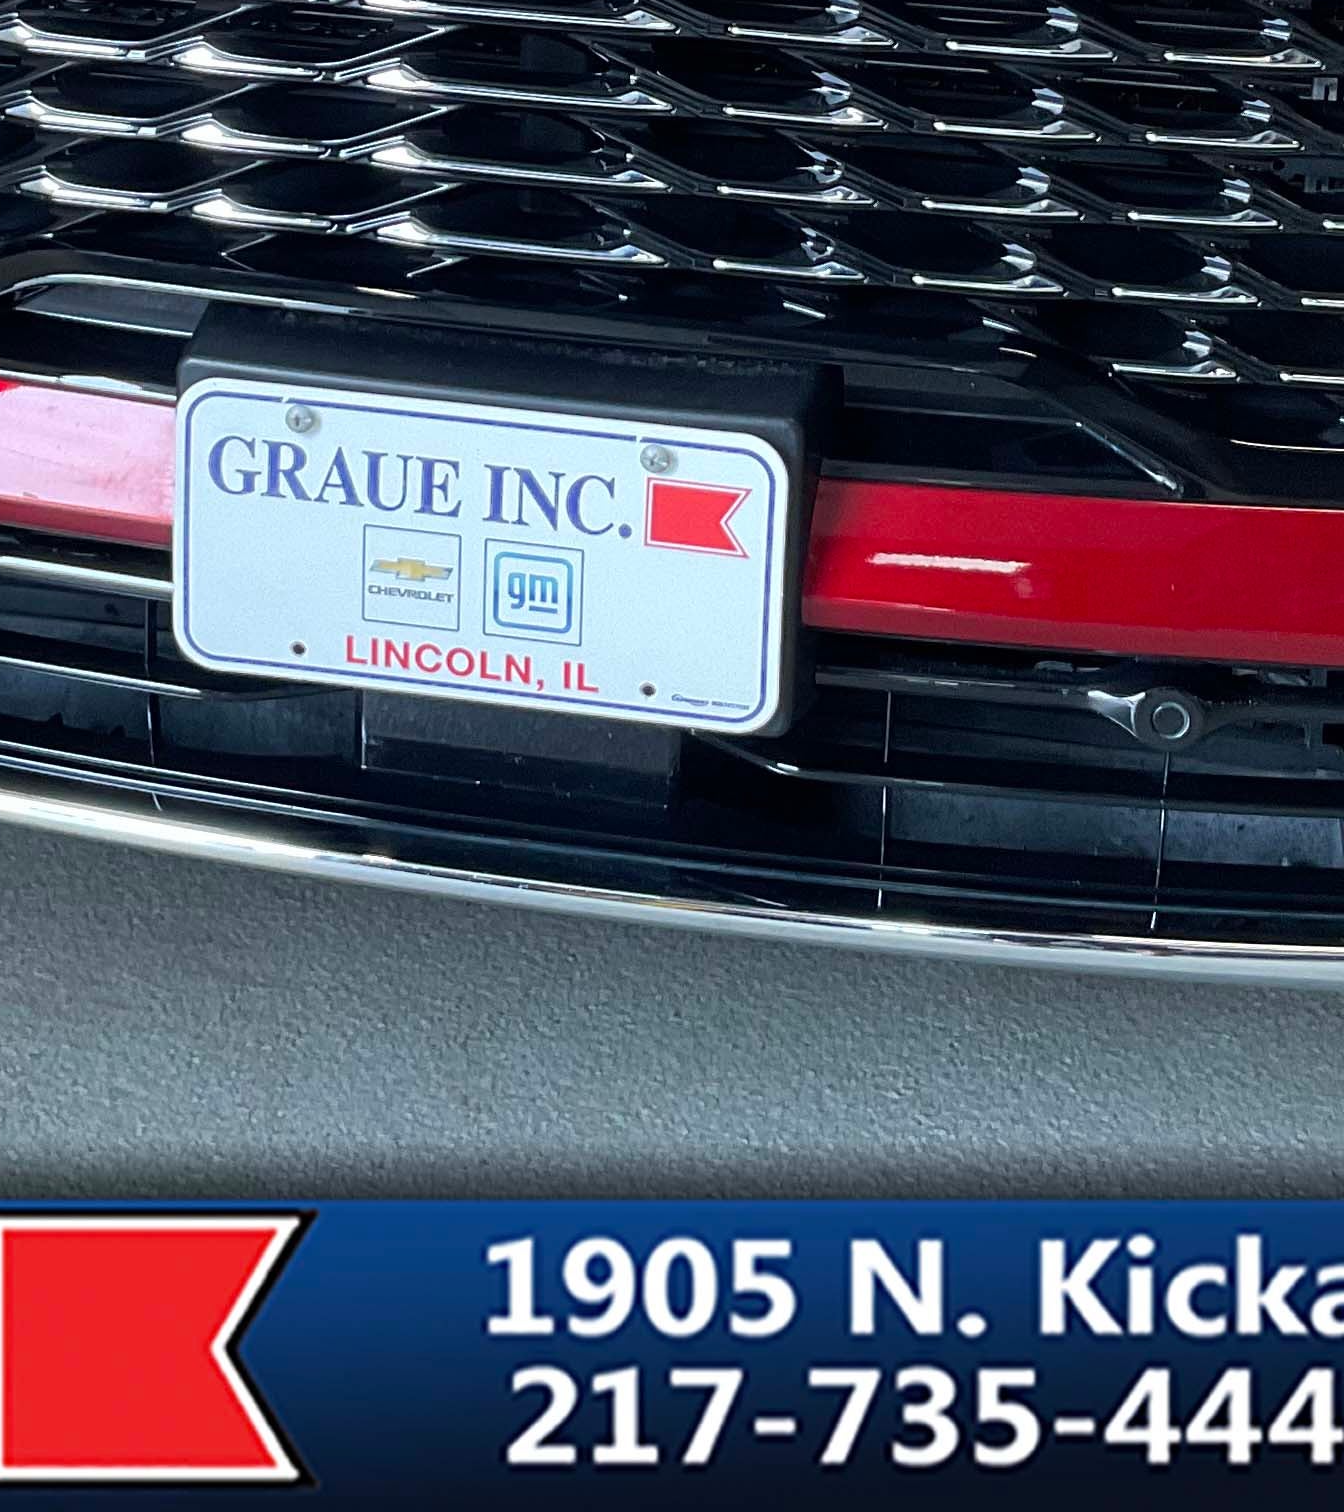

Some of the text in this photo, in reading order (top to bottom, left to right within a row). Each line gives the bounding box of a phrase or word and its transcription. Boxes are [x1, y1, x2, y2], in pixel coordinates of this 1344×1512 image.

[207, 434, 633, 540] GRAUE INC.
[367, 584, 455, 603] CHEVROLET
[507, 571, 559, 614] gm
[345, 634, 600, 693] LINCOLN, IL
